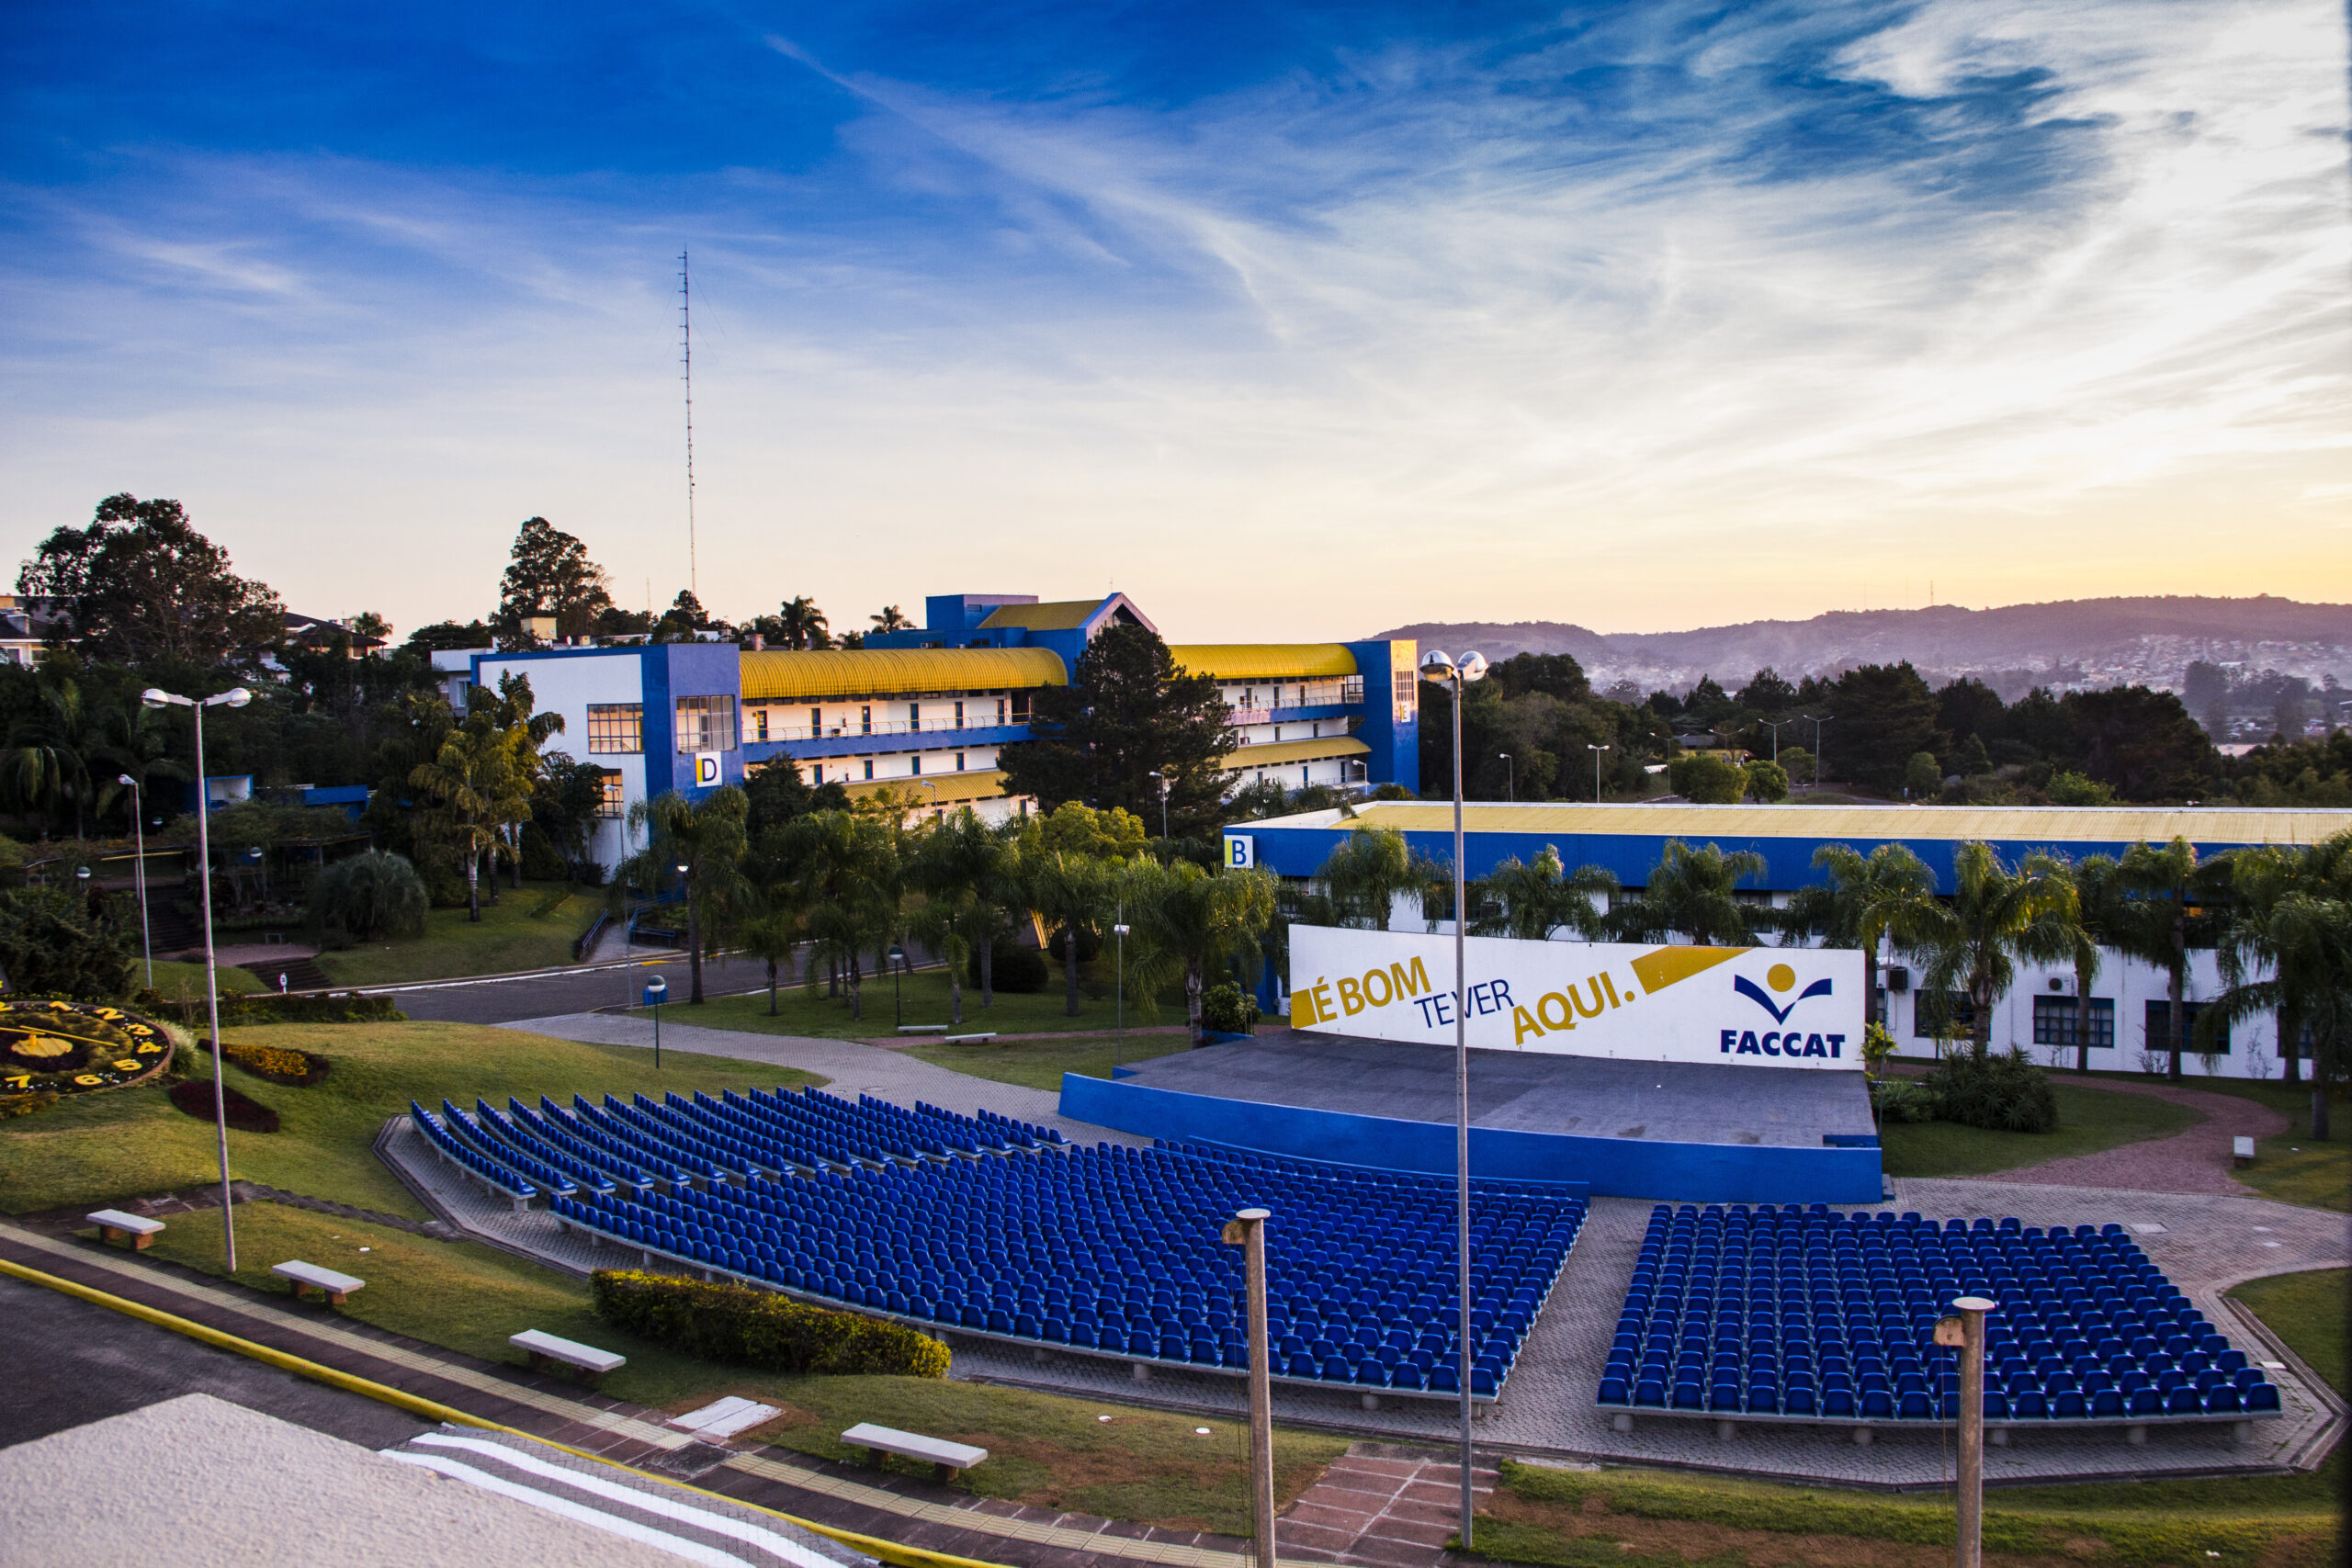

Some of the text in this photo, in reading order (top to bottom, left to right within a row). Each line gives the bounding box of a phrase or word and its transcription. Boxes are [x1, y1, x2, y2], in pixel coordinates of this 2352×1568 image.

[702, 758, 718, 782] D
[1232, 840, 1247, 865] B
[1311, 955, 1431, 1022] É BOM
[49, 1000, 73, 1010] 1
[1413, 978, 1515, 1028] TE VER
[1512, 971, 1635, 1046] AQUI.
[96, 1008, 125, 1021] 2
[127, 1023, 154, 1036] 3
[137, 1041, 163, 1054] 4
[1720, 1029, 1846, 1058] FACCAT
[112, 1058, 142, 1071] 5
[5, 1075, 31, 1089] 7
[74, 1074, 104, 1086] 6
